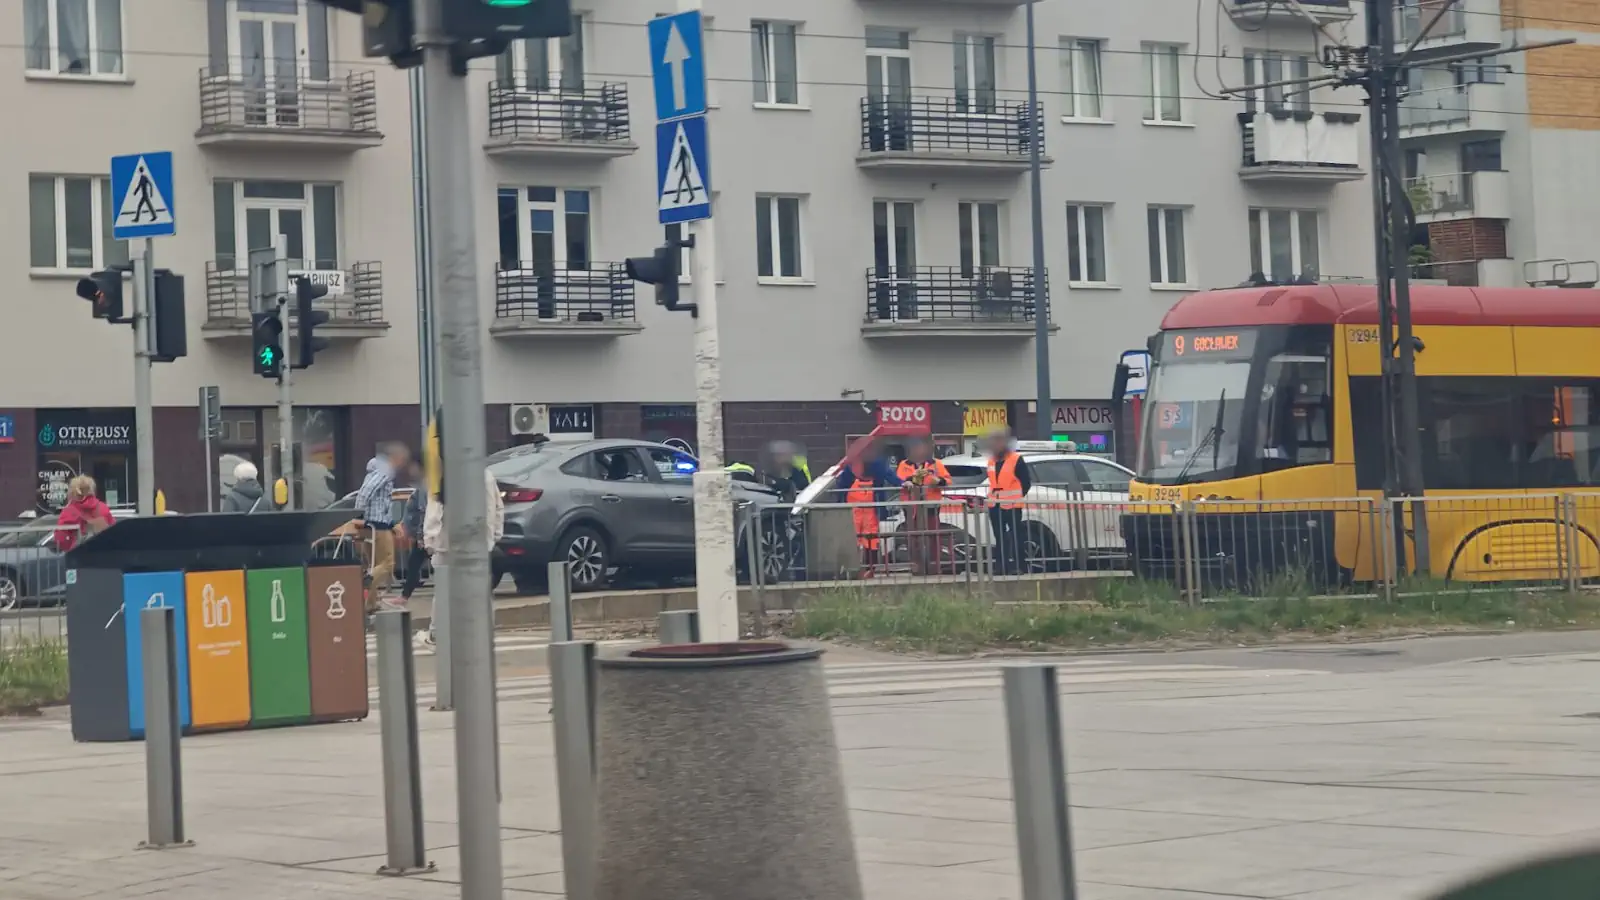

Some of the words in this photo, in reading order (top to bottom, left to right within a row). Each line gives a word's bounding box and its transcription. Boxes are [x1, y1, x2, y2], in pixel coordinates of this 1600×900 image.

[1175, 335, 1185, 355] 9
[881, 406, 926, 422] FOTO
[1052, 406, 1112, 424] ANTOR
[58, 426, 130, 441] OTRĘBUSY
[1155, 487, 1181, 501] 3294
